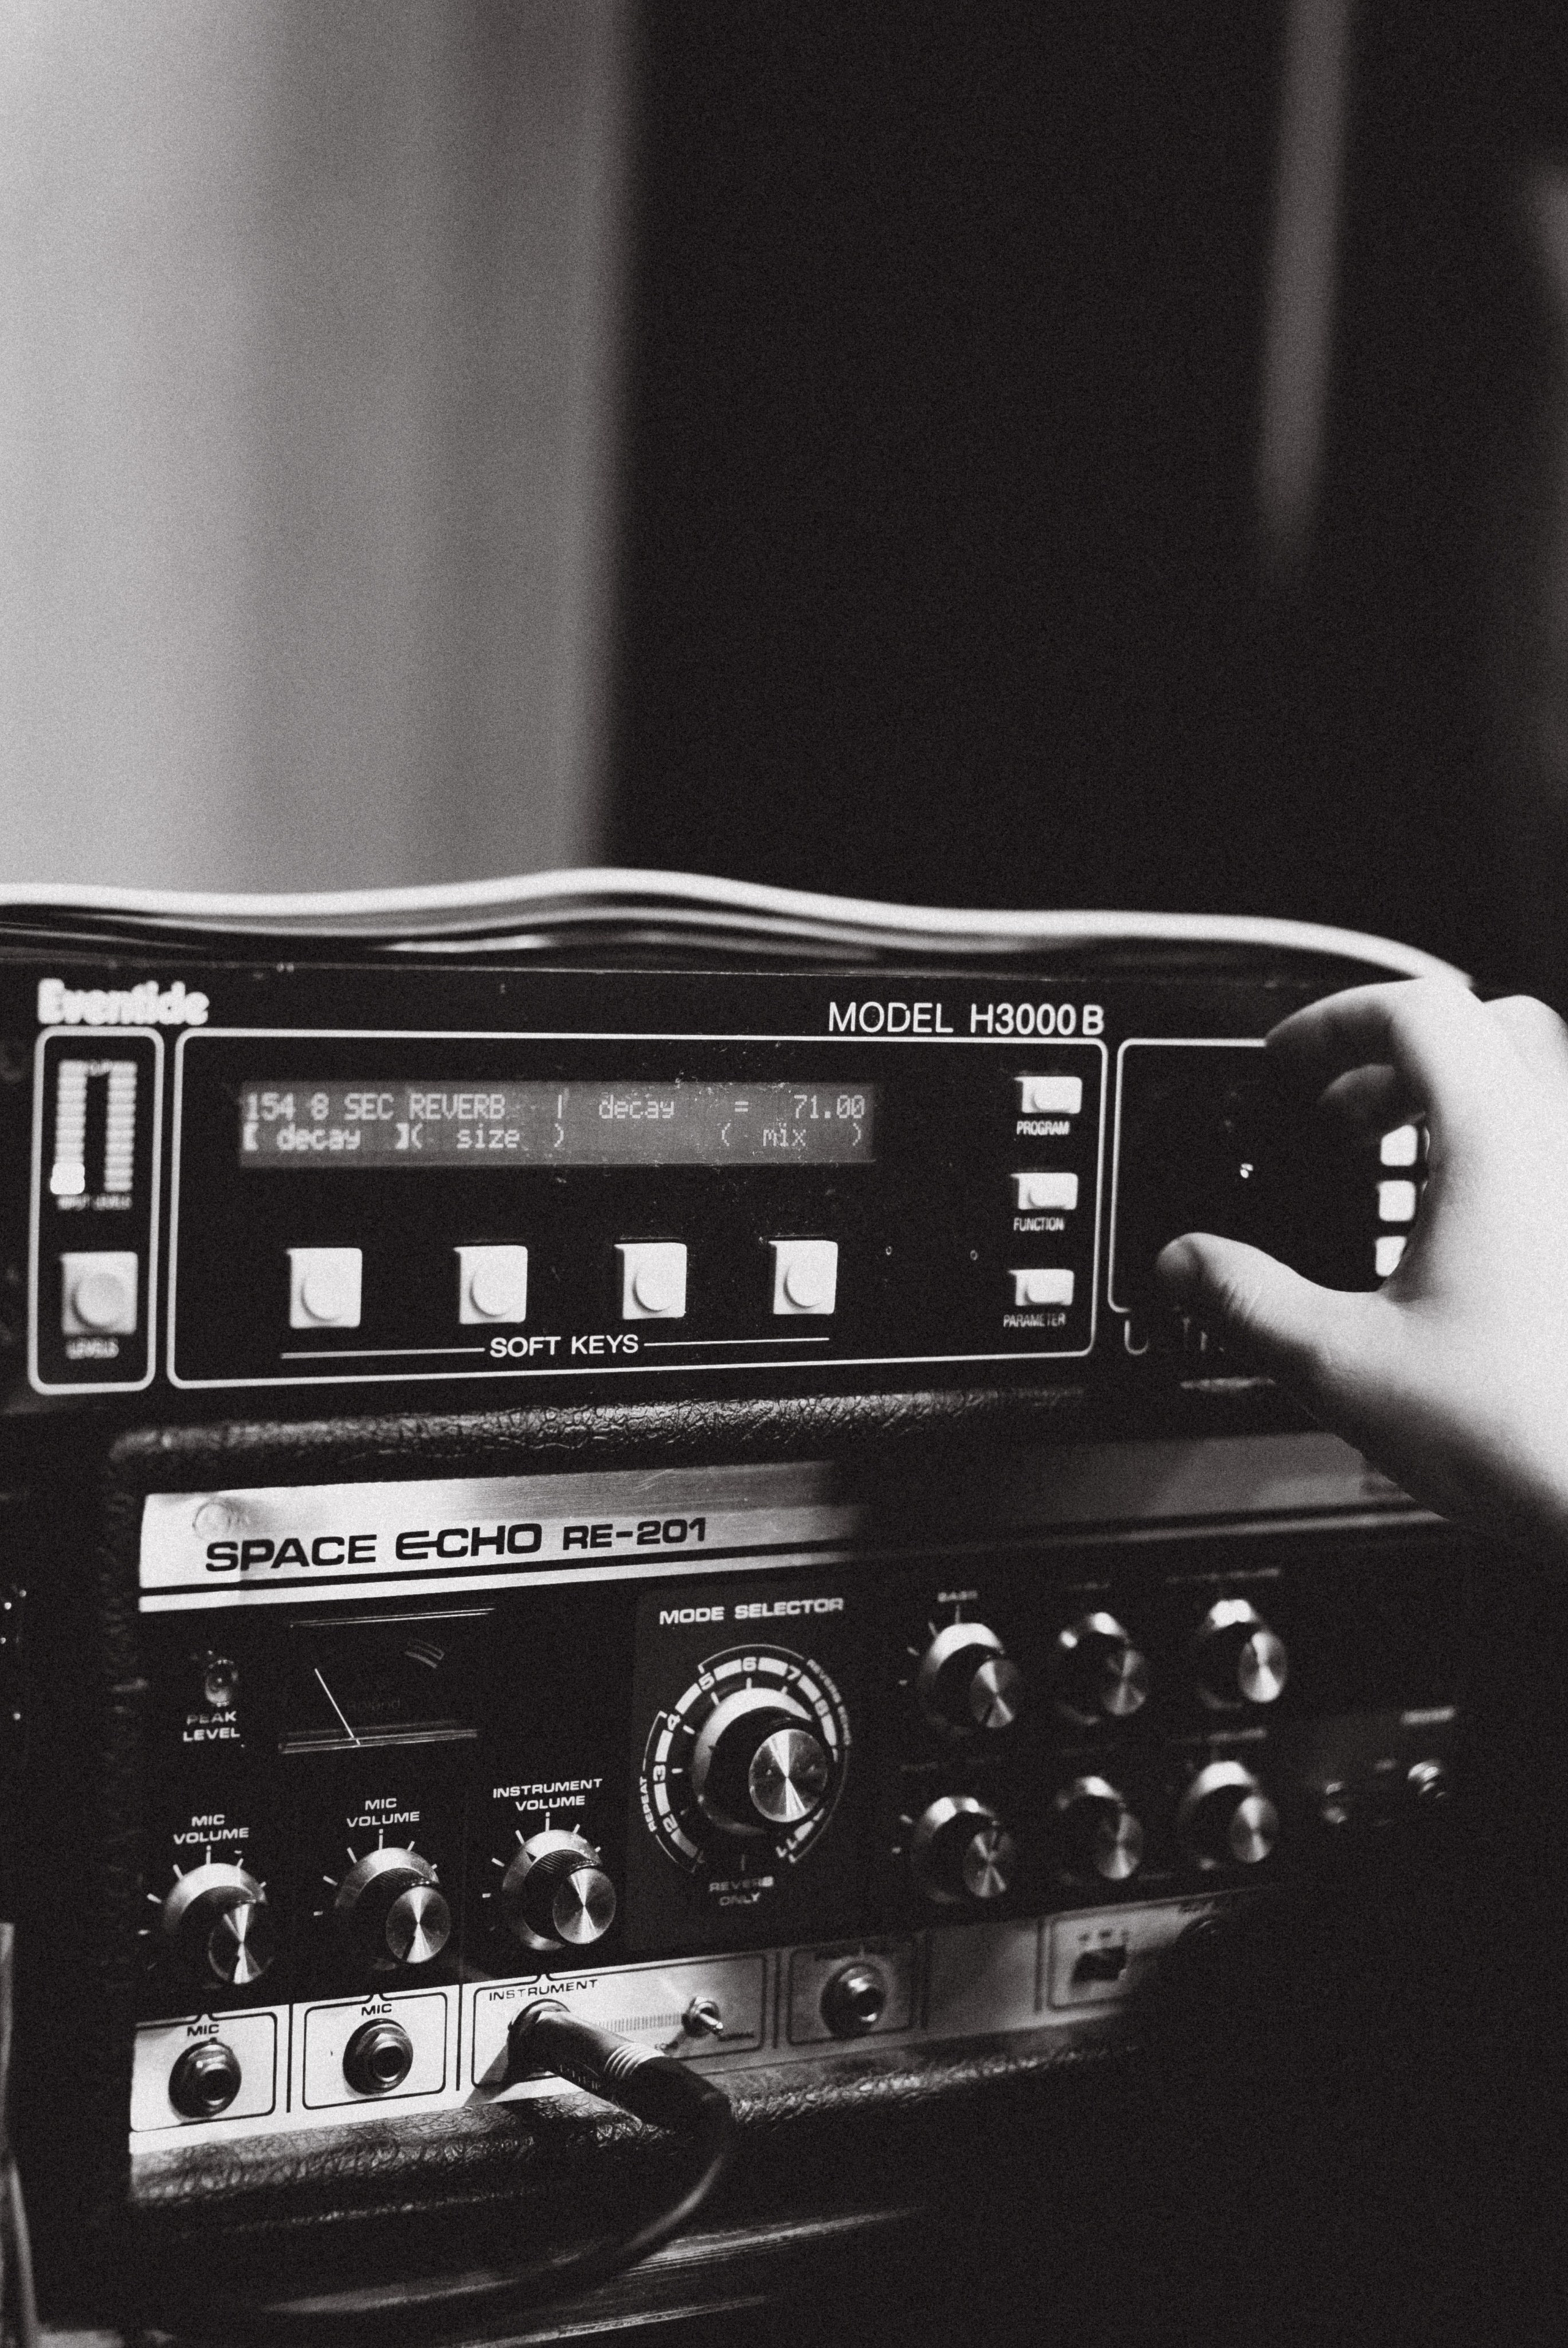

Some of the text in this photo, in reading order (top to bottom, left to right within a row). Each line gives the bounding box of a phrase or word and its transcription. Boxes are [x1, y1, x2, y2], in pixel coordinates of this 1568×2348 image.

[829, 1002, 954, 1033] MODEL
[247, 1093, 296, 1121] 154
[308, 1093, 329, 1120] 8
[344, 1093, 393, 1120] SEC
[410, 1093, 505, 1120] REVERB
[599, 1093, 674, 1119] decay
[794, 1095, 864, 1119] 71.00
[277, 1123, 360, 1150] decay
[457, 1123, 520, 1149] size
[1017, 1121, 1069, 1135] PROGRAM
[1014, 1217, 1065, 1231] FUNCTION
[1003, 1313, 1066, 1327] PARAMETER
[490, 1334, 638, 1357] SOFT KEYS
[206, 1517, 706, 1572] SPACE ECHO RE-201
[660, 1598, 843, 1625] MODE SELECTOR
[187, 1711, 236, 1724] PEAK
[183, 1727, 239, 1742] LEVEL
[493, 1778, 602, 1798] INSTRUMENT
[365, 1798, 396, 1810] MIC
[515, 1795, 585, 1812] VOLUME
[639, 1775, 657, 1832] REPEAT
[192, 1814, 224, 1826] MIC
[347, 1811, 420, 1827] VOLUME
[173, 1827, 248, 1844] VOLUME
[489, 1979, 598, 2001] INSTRUMENT
[361, 2004, 393, 2016] MIC
[186, 2023, 221, 2037] MIC
